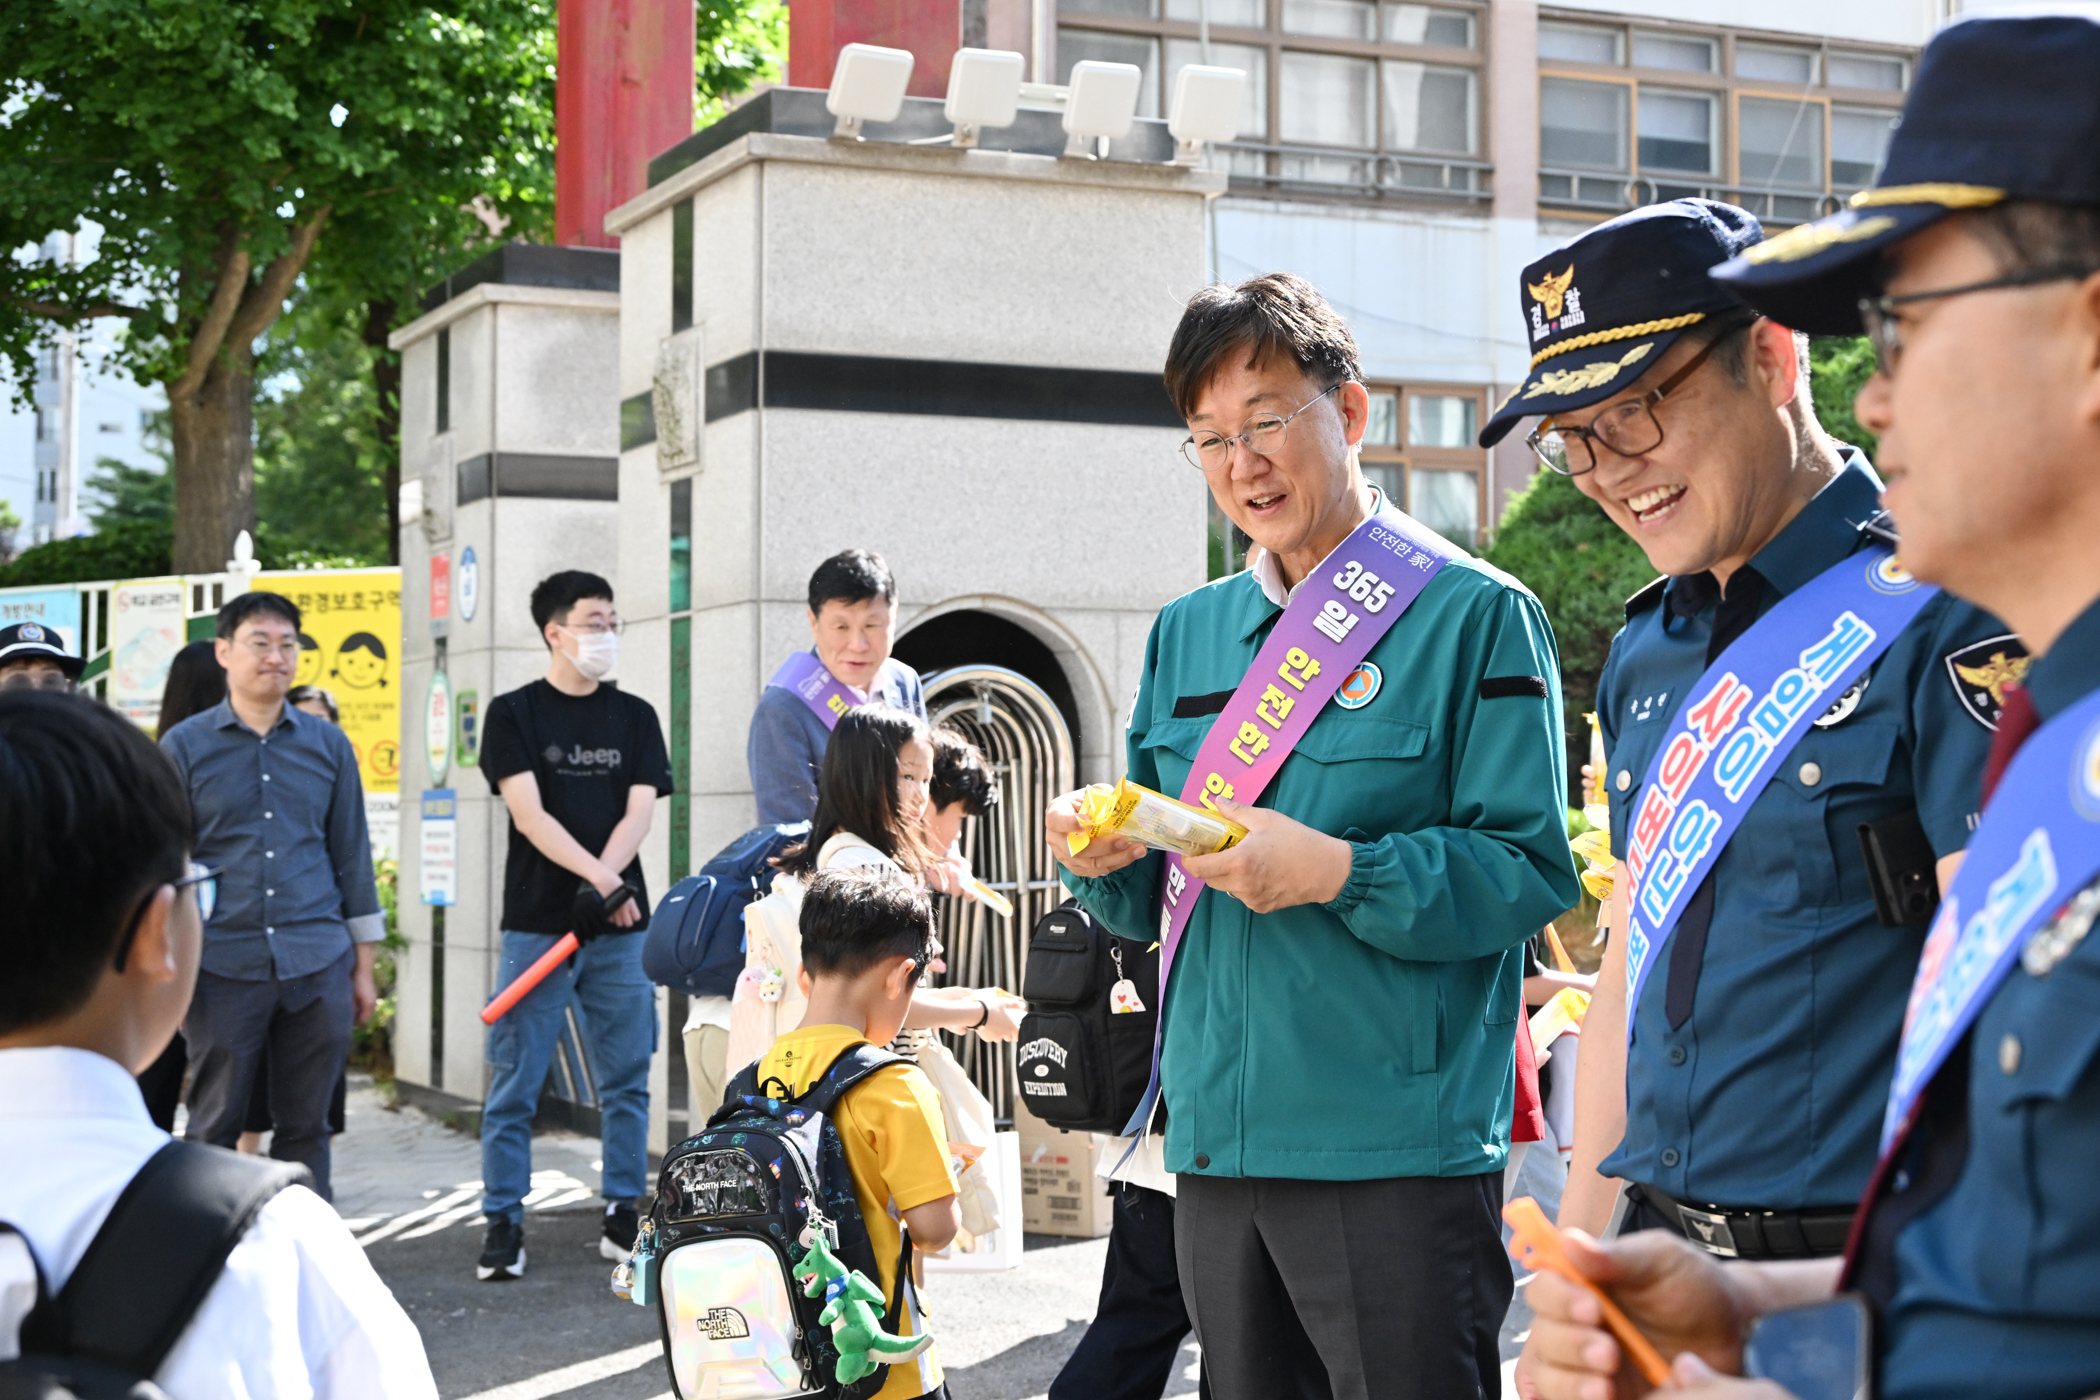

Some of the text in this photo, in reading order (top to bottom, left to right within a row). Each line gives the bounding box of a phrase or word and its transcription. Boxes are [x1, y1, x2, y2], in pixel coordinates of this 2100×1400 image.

[1368, 526, 1413, 558] 안전한
[1230, 645, 1322, 766] 안전한
[567, 744, 622, 768] Jeep
[1019, 1038, 1067, 1069] DISCOVERY
[1024, 1081, 1067, 1096] EXPEDITION
[696, 1181, 719, 1191] NORTH
[720, 1179, 737, 1188] FACE
[709, 1309, 727, 1320] THE
[697, 1319, 728, 1330] NORTH
[709, 1329, 731, 1338] FACE
